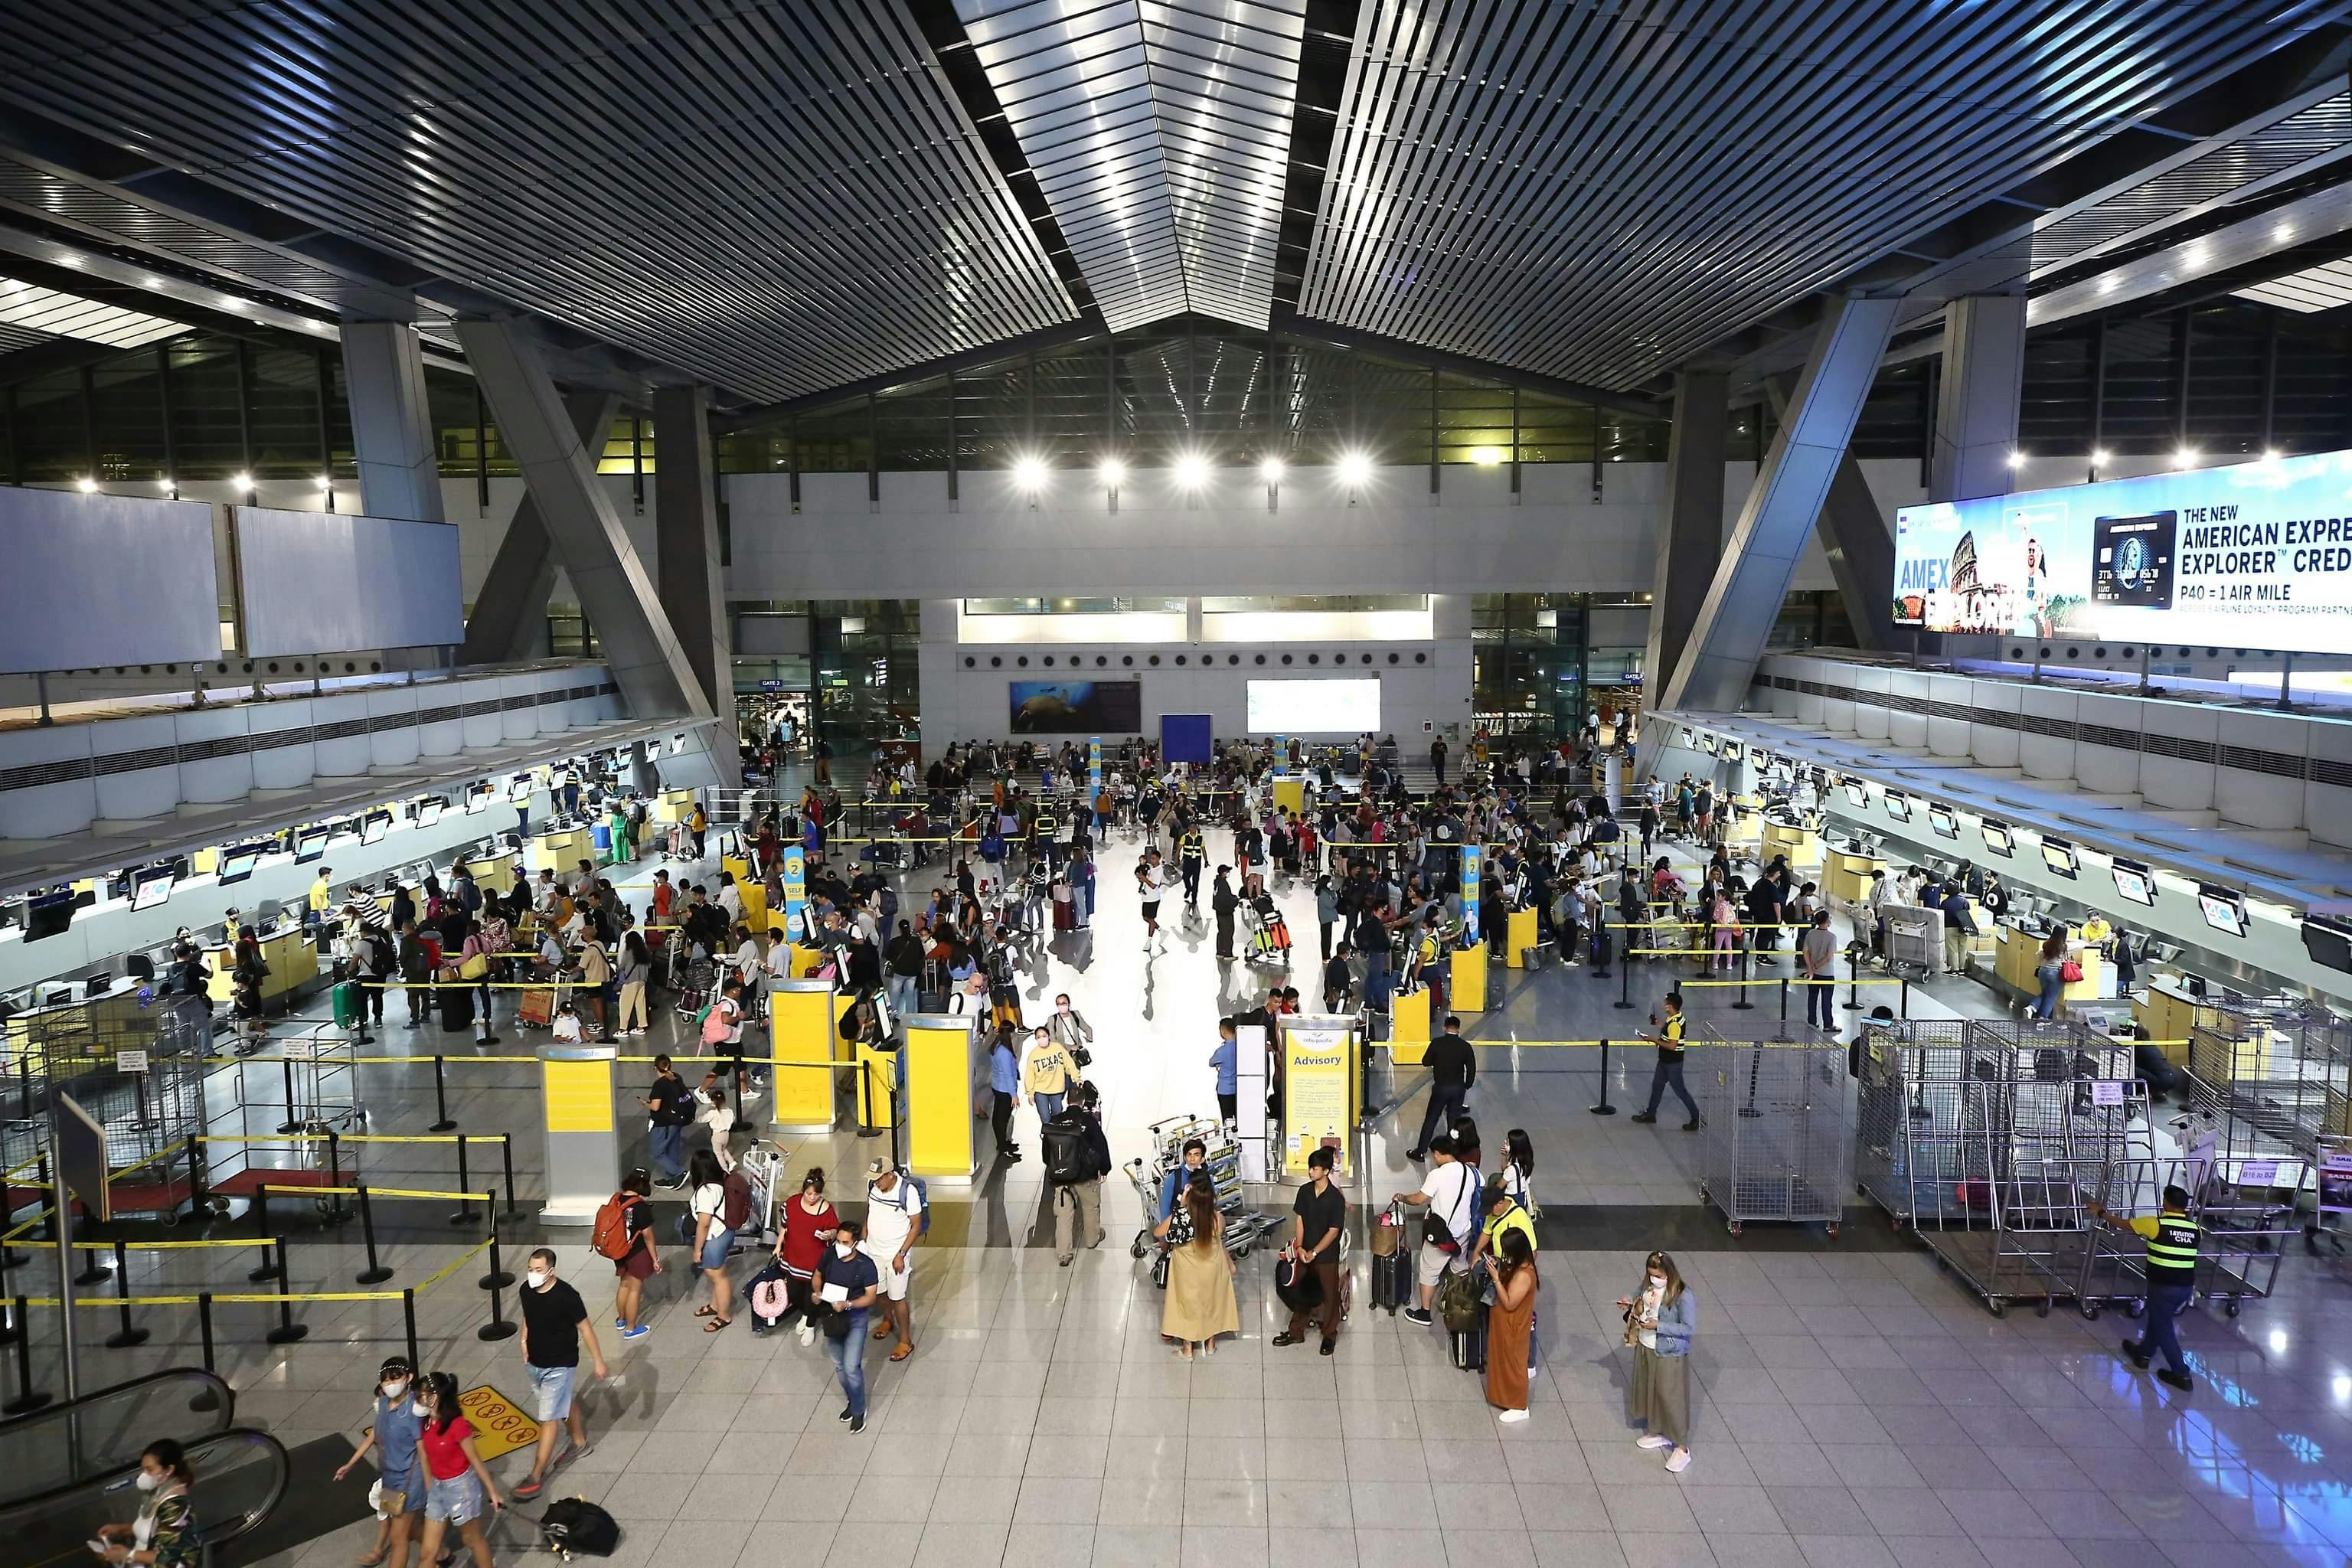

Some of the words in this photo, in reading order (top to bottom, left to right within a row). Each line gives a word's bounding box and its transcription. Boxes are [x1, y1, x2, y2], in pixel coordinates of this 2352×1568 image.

[2184, 508, 2207, 523] THE
[2210, 505, 2239, 521] NEW
[2183, 522, 2278, 549] AMERICAN
[2285, 517, 2352, 544] EXPRE
[2294, 547, 2352, 573] CRED
[1900, 558, 1949, 589] AMEX
[2180, 586, 2204, 600] P40
[2220, 586, 2226, 599] 1
[2230, 585, 2252, 600] AIR
[2257, 584, 2291, 600] MILE
[2243, 604, 2275, 614] LOYALTY
[2278, 605, 2318, 614] PROGRAM
[2321, 606, 2352, 615] PARTN
[791, 865, 798, 874] 2
[1469, 864, 1475, 874] 2
[1034, 1052, 1063, 1072] TEXAS
[1294, 1056, 1341, 1066] Advisory
[2174, 1236, 2192, 1244] CHA
